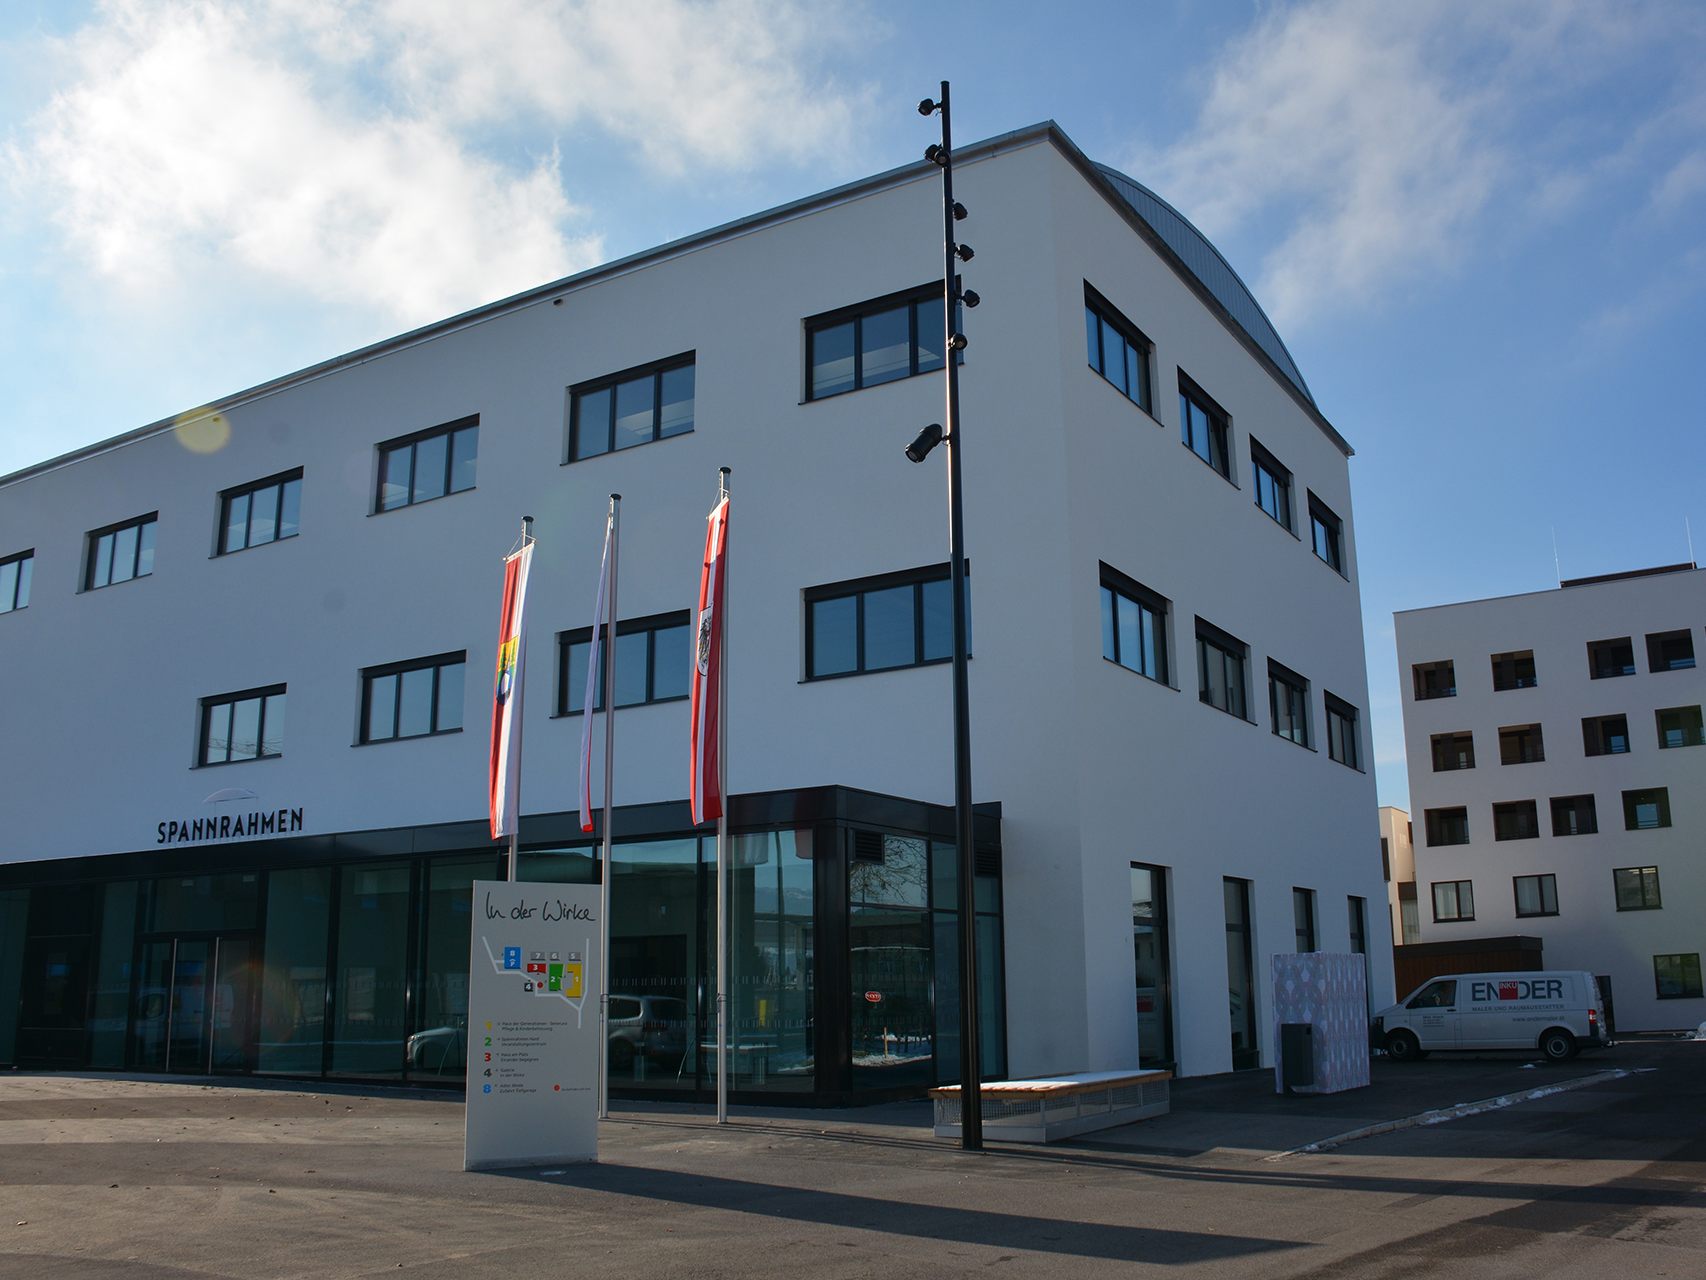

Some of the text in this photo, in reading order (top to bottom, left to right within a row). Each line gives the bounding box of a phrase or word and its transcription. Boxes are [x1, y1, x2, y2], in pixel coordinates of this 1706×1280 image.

[157, 807, 304, 844] SPANNRAHMEN
[486, 891, 596, 921] In der Wirke
[484, 1037, 492, 1047] 2
[484, 1052, 491, 1062] 3
[483, 1068, 492, 1078] 4
[482, 1083, 492, 1094] 8
